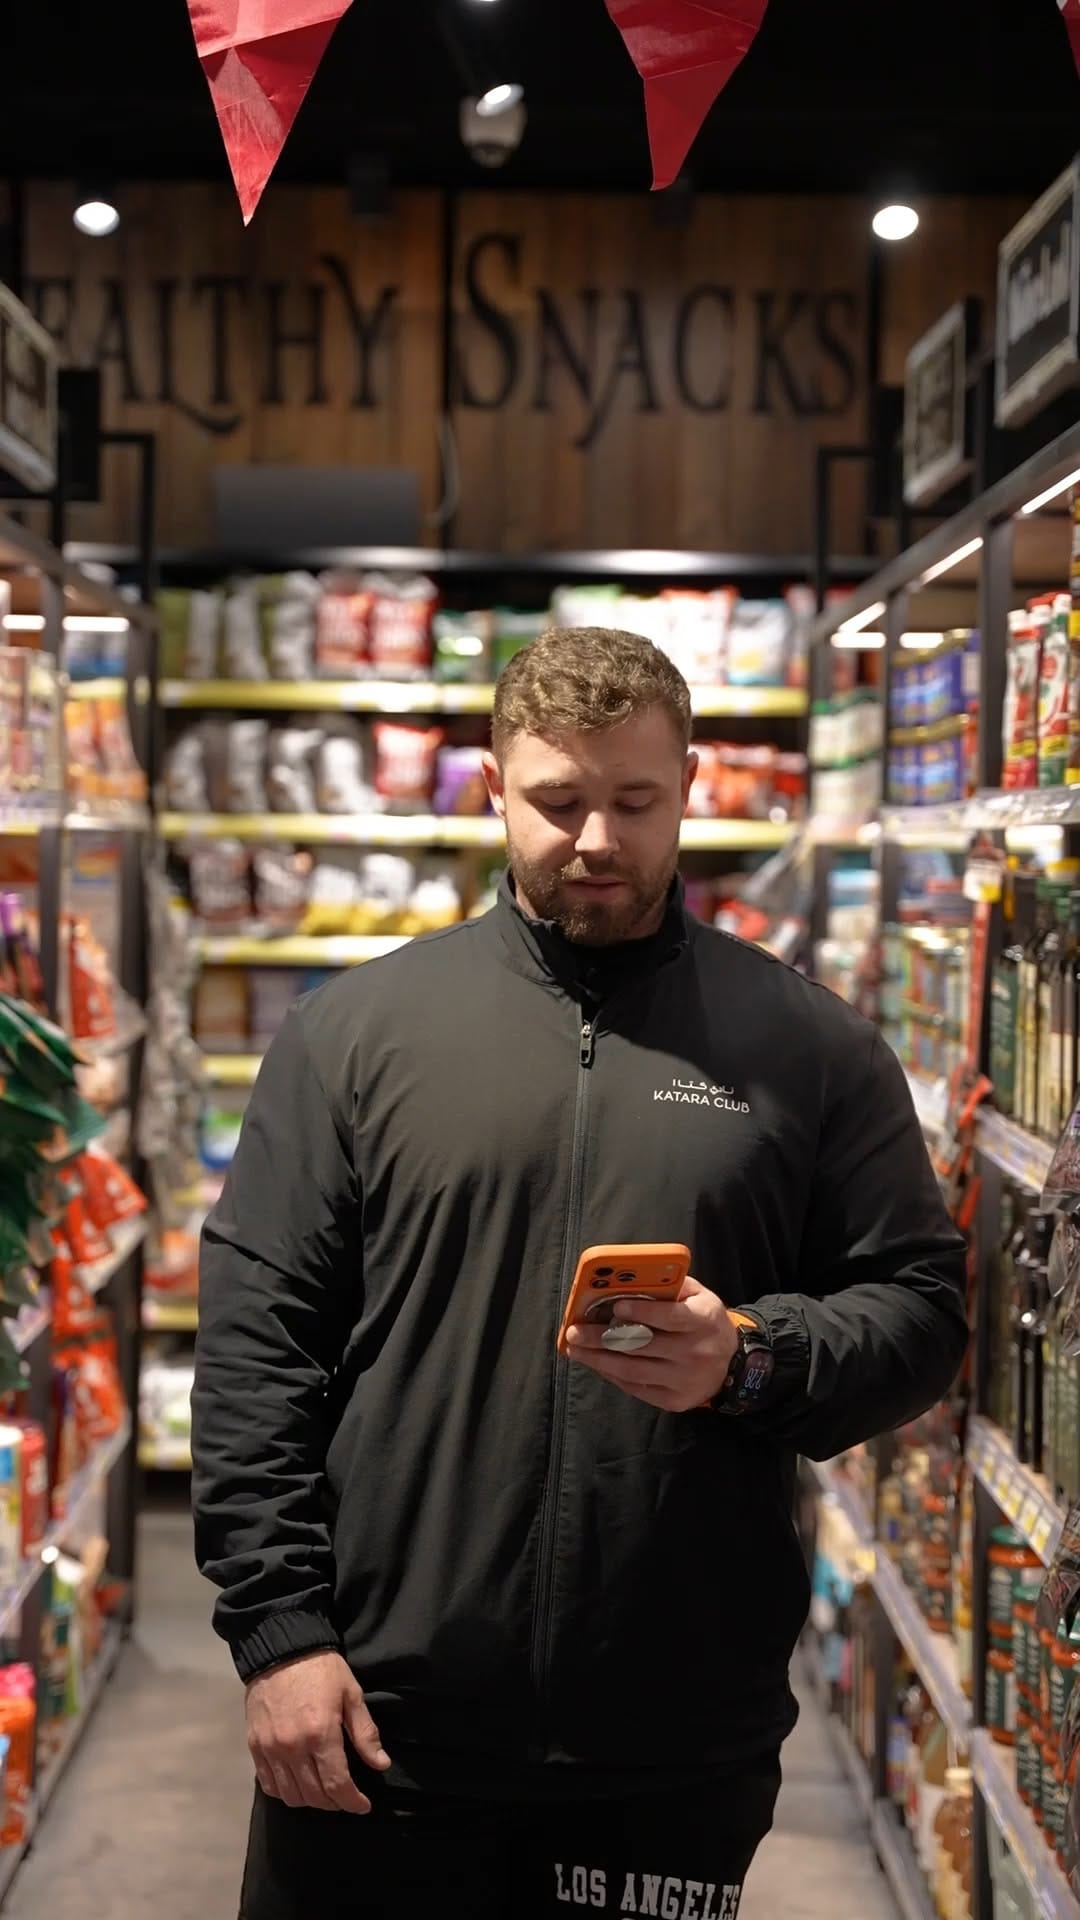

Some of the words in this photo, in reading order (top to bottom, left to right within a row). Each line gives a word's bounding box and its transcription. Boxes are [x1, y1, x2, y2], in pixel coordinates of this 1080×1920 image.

[460, 230, 858, 449] SNACKS
[653, 1090, 710, 1106] KATARA
[713, 1097, 750, 1113] CLUB
[554, 1863, 607, 1908] LOS
[620, 1872, 741, 1920] ANGELES
